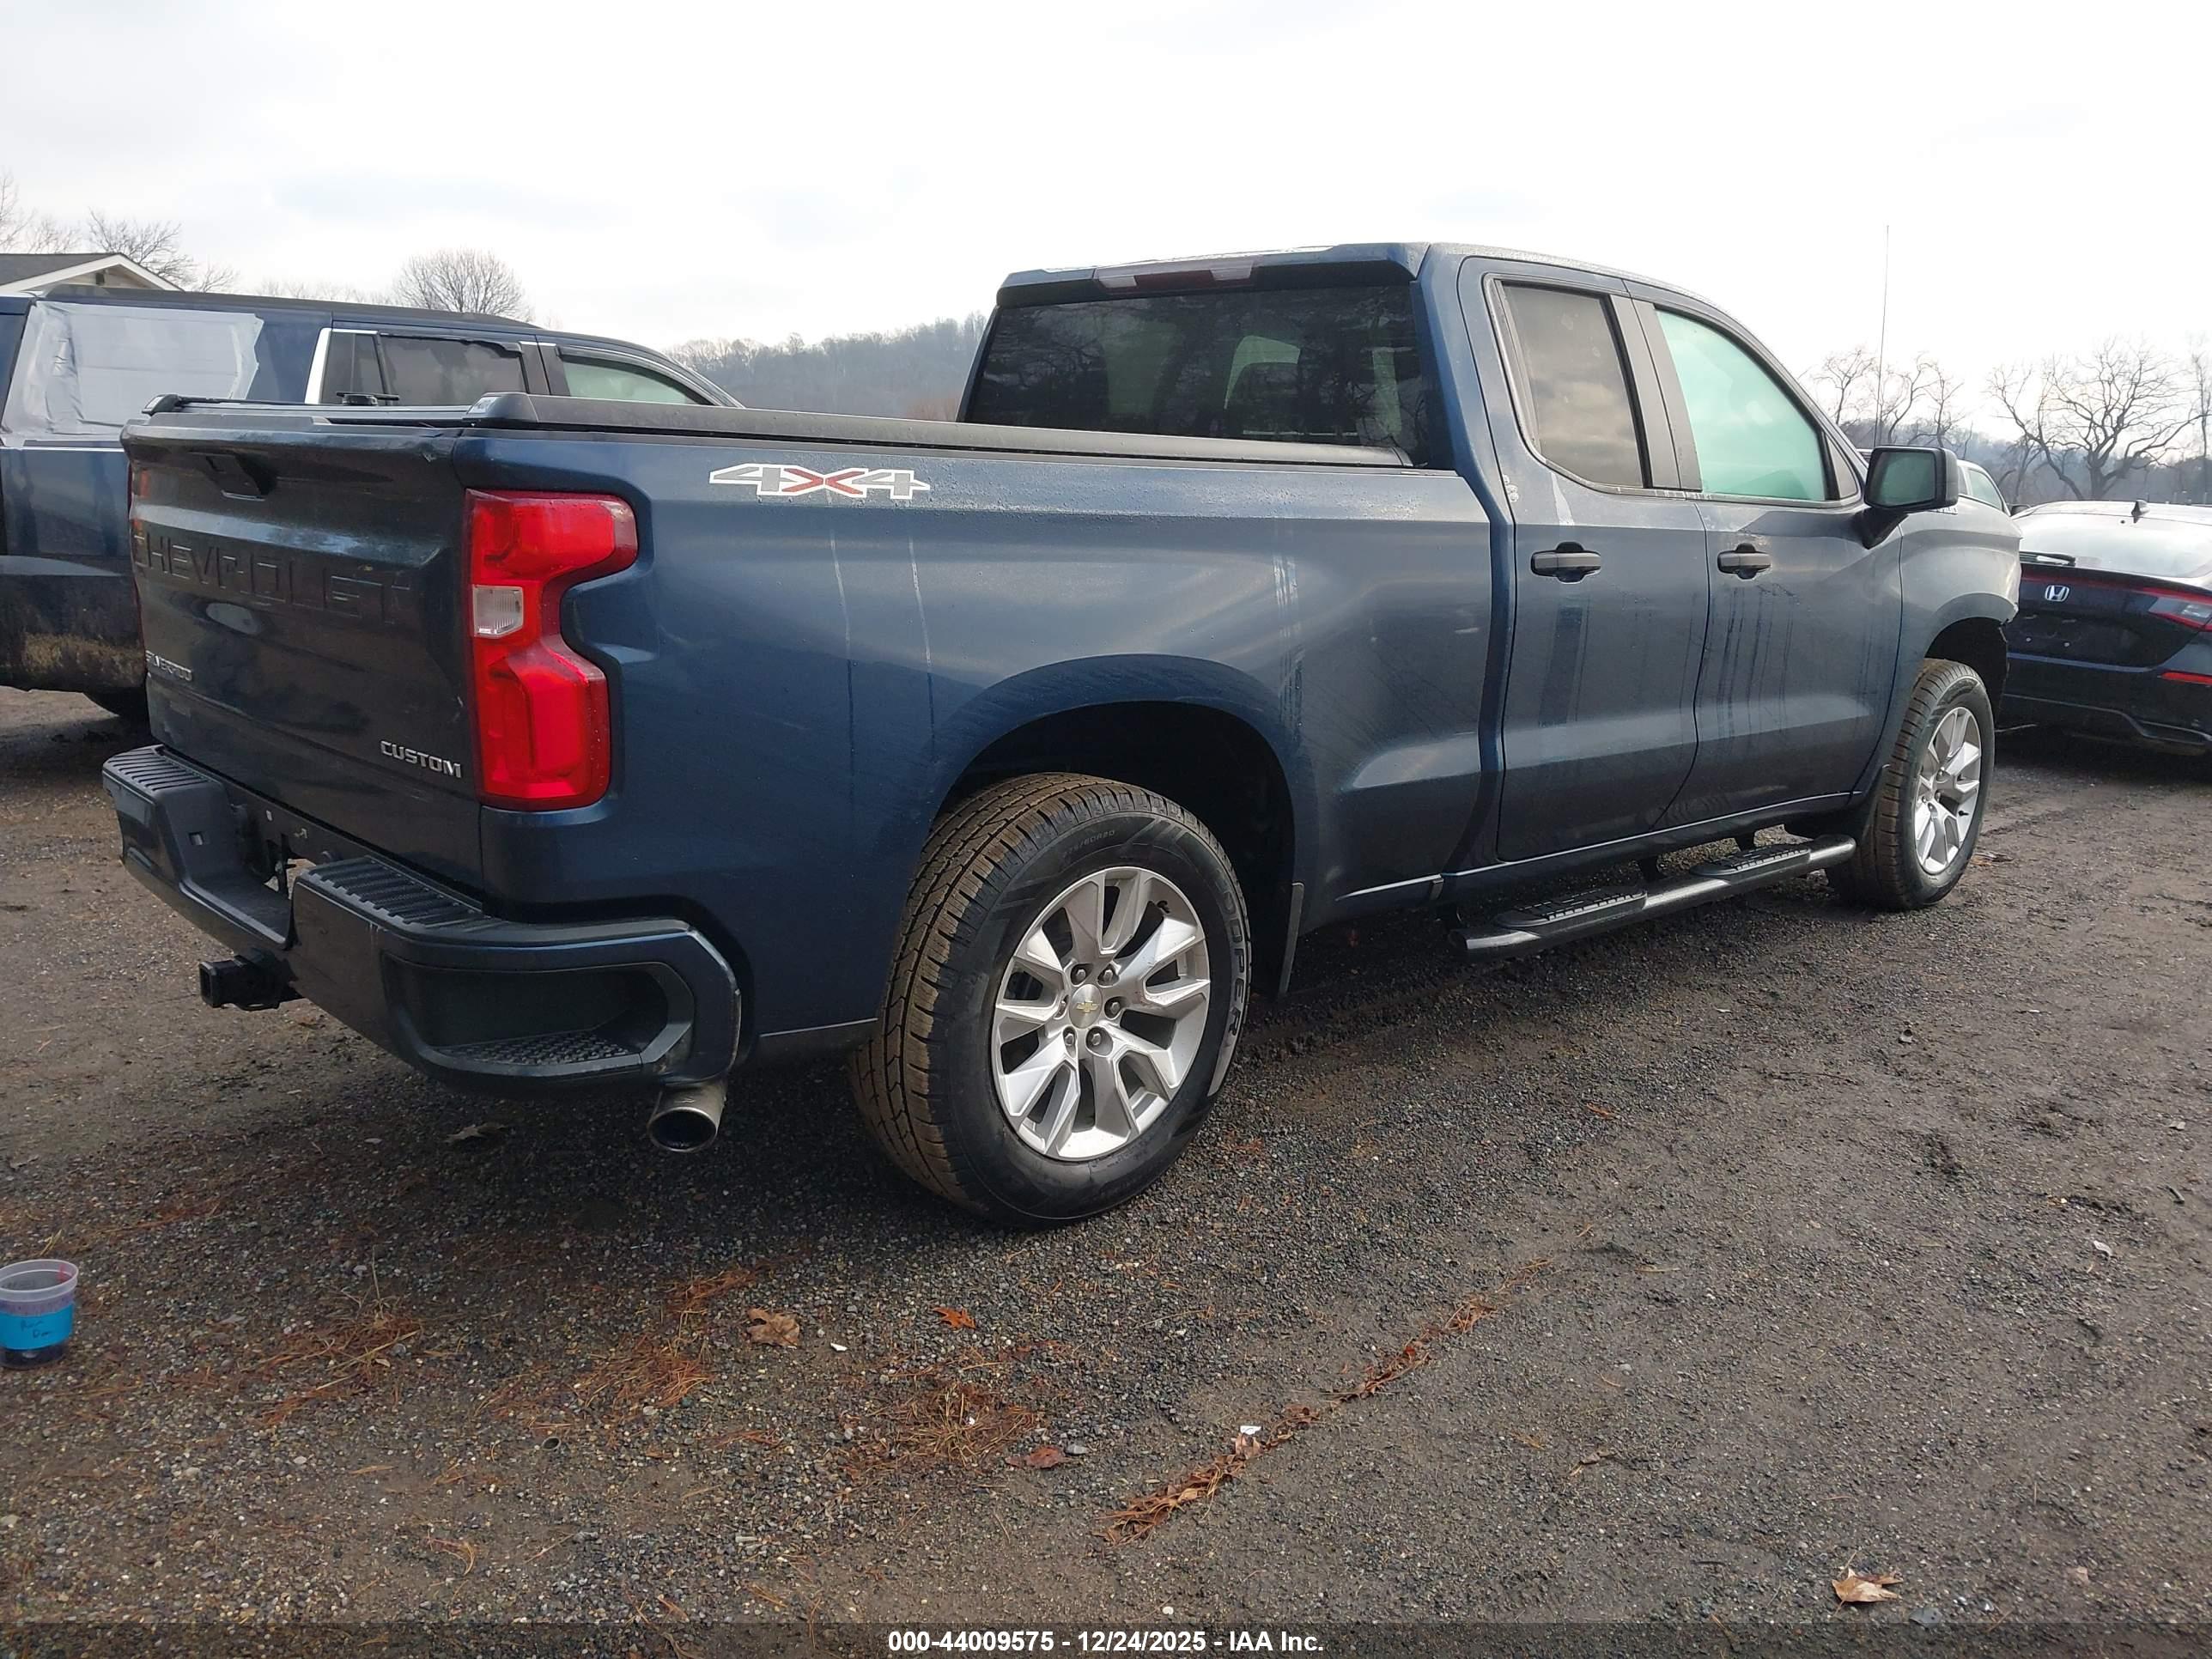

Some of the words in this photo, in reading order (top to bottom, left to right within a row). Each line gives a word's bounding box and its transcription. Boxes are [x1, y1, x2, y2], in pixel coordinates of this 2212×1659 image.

[132, 532, 411, 625] CHEVROLET
[145, 649, 192, 681] SVERADO
[380, 739, 461, 778] CUSTOM
